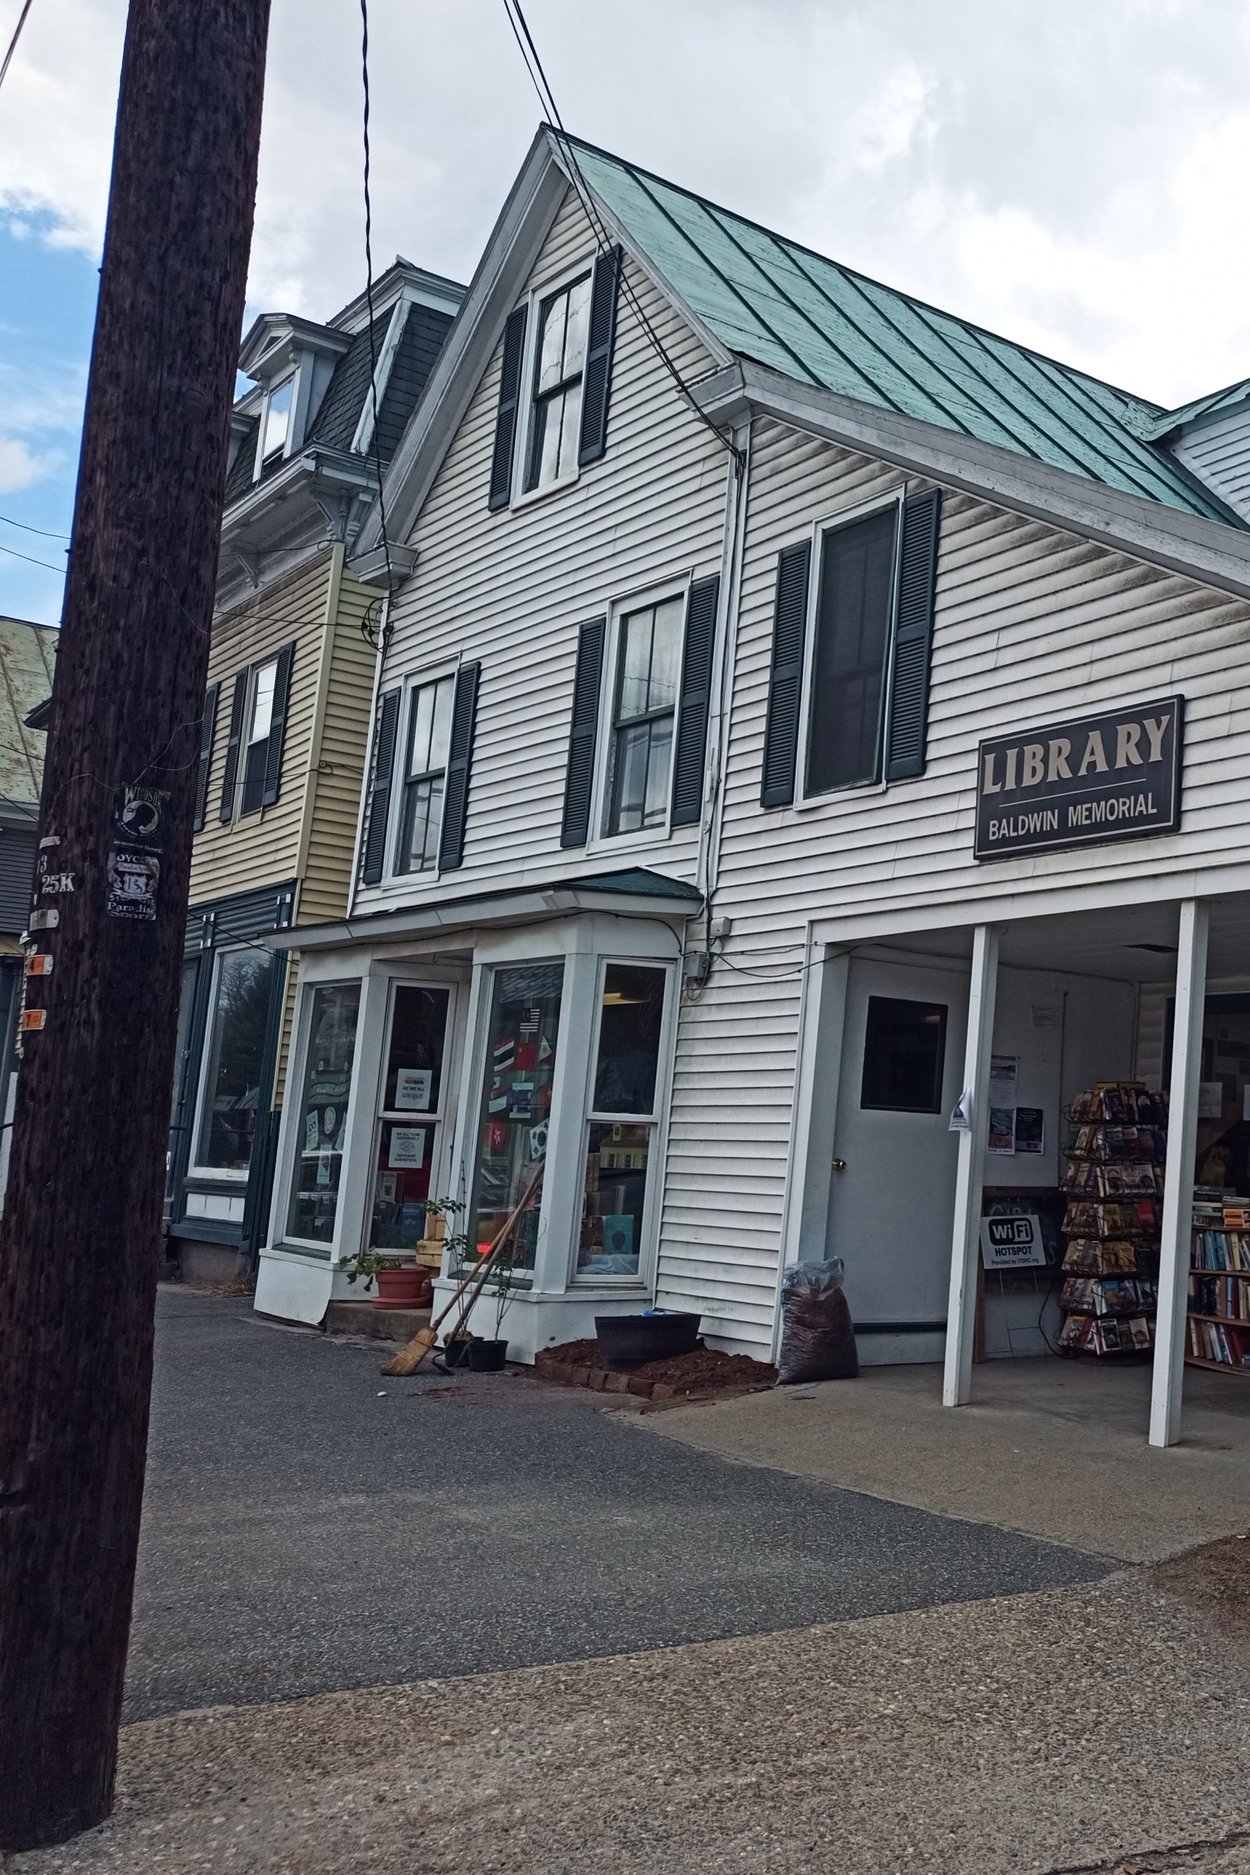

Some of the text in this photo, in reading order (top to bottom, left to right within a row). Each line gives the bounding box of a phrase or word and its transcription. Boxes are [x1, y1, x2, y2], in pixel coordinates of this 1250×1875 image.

[982, 715, 1171, 795] LIBRARY
[989, 792, 1157, 841] BALDWIN MEMORIAL
[41, 872, 75, 894] 25K
[995, 1245, 1032, 1257] HOTSPOT
